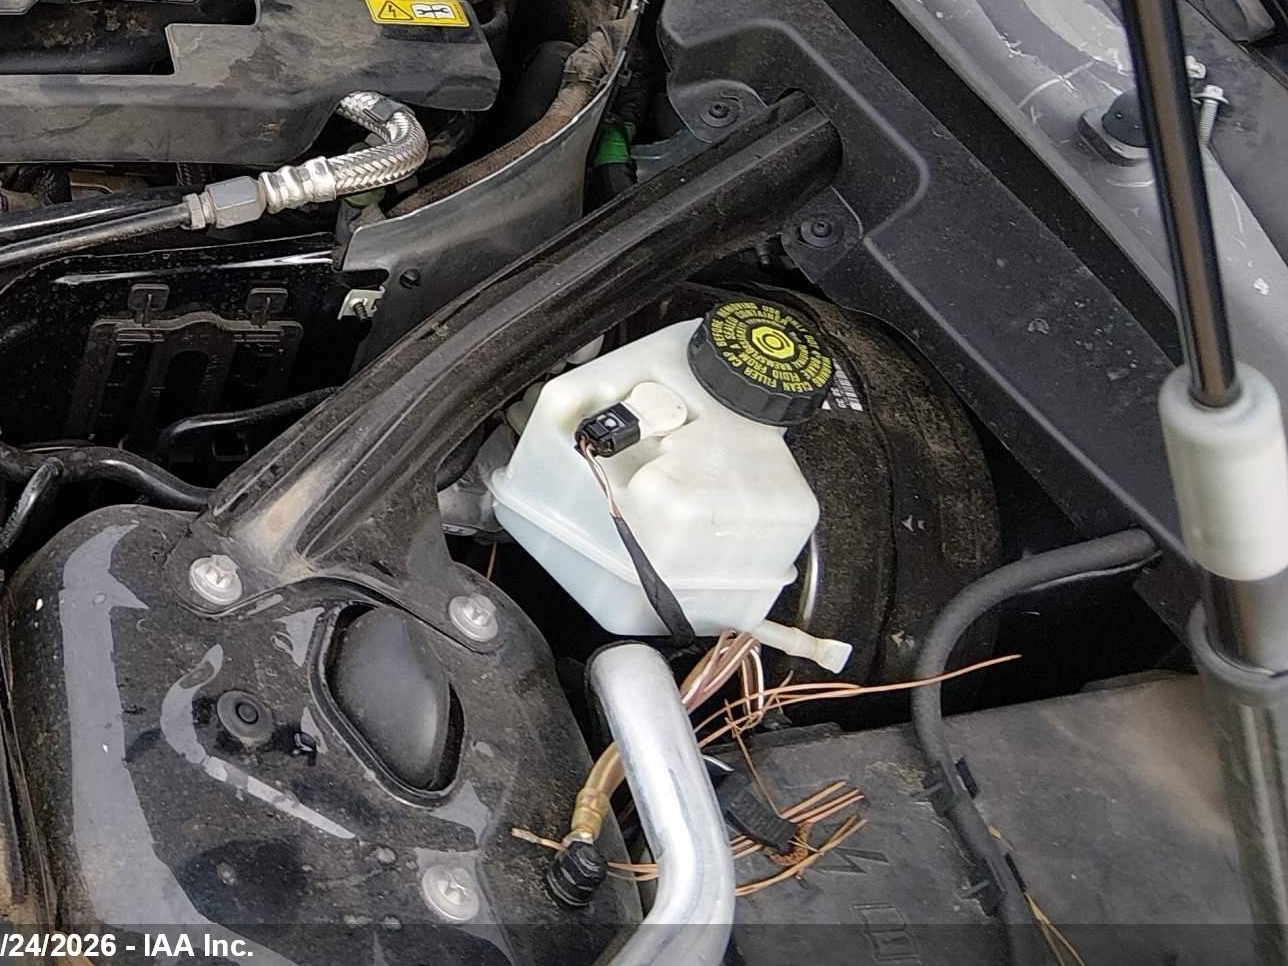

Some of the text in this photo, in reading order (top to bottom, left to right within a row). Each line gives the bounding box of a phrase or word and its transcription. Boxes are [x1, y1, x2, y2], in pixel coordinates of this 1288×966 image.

[712, 319, 727, 347] BEFORE
[723, 316, 739, 340] SEALED
[723, 351, 743, 367] CAP
[738, 352, 767, 373] FROM
[744, 366, 776, 388] FILLER
[772, 369, 800, 382] FLUID
[783, 381, 813, 392] CLEAN
